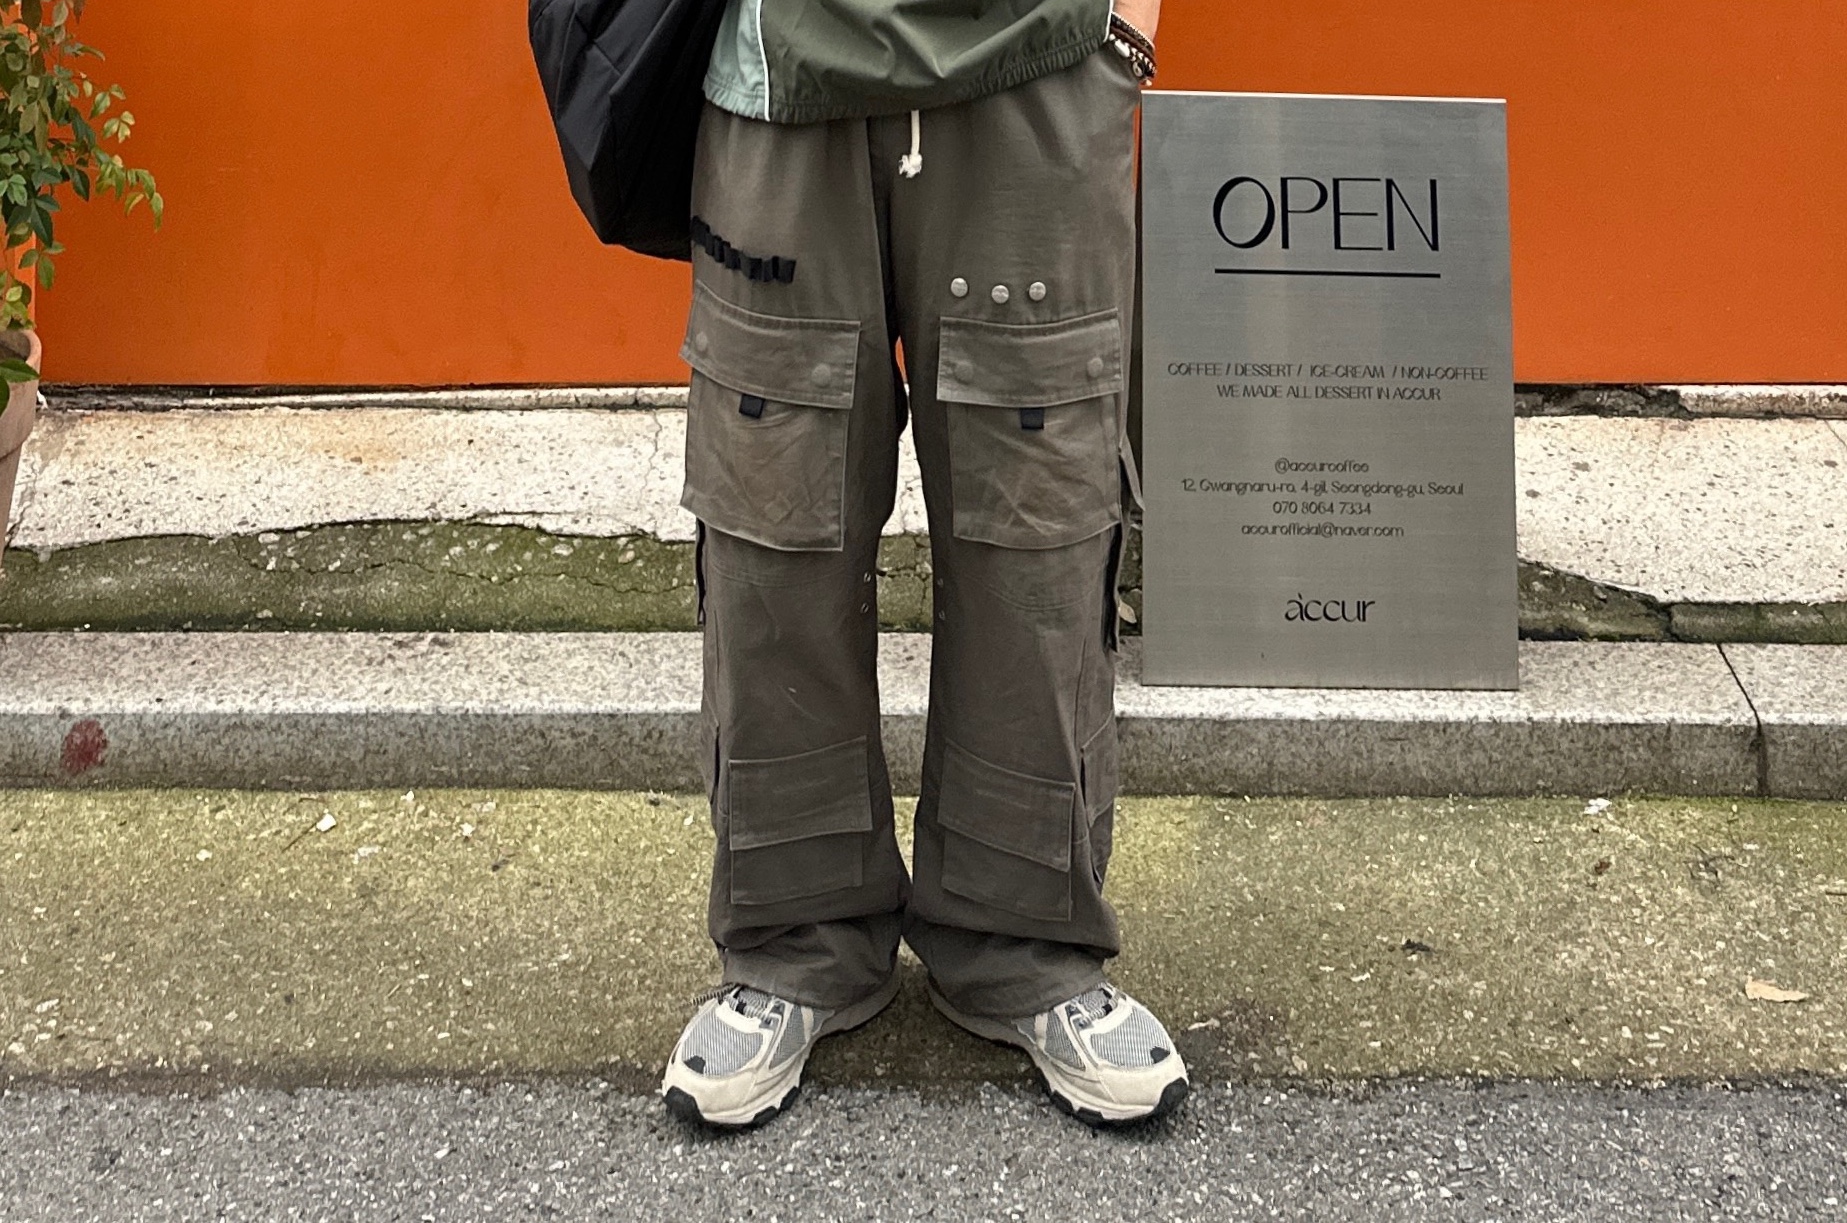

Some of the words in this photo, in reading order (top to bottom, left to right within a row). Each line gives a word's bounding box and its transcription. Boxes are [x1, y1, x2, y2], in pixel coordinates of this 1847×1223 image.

[1212, 176, 1440, 252] OPEN
[1167, 362, 1223, 376] COFFEE
[1234, 363, 1294, 377] DESSERT
[1309, 364, 1385, 378] ICE-CREAM
[1400, 364, 1489, 380] NON-COFFEE
[1216, 384, 1241, 398] WE
[1242, 384, 1283, 398] MADE
[1286, 384, 1312, 398] ALL
[1314, 385, 1374, 399] DESSERT
[1376, 386, 1390, 400] IN
[1392, 386, 1442, 401] ACCUR
[1427, 481, 1465, 496] Seoul
[1272, 500, 1298, 516] 070
[1301, 501, 1334, 516] 8064
[1338, 501, 1372, 516] 7334
